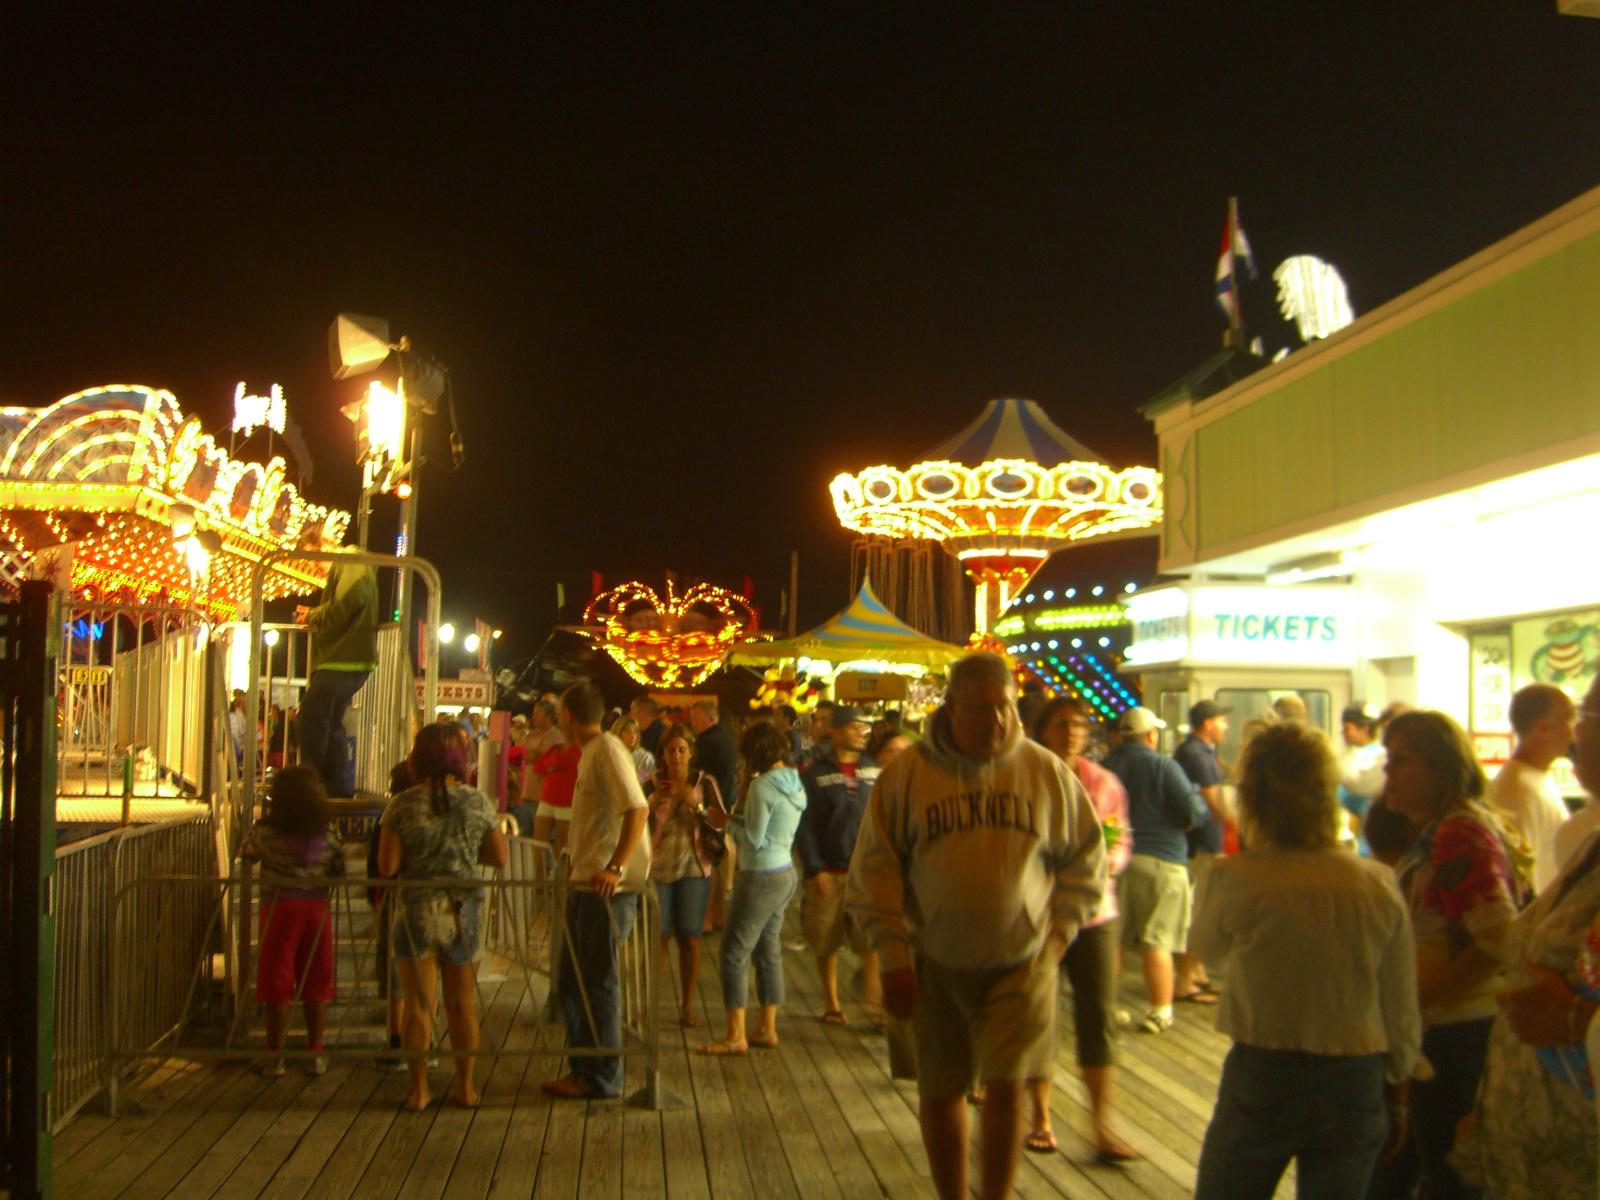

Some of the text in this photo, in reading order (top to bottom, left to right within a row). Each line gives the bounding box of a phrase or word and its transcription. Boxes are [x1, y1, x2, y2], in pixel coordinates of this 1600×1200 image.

[1214, 614, 1336, 641] TICKETS
[416, 686, 483, 698] TKETS
[925, 791, 1040, 843] BUCKNELL
